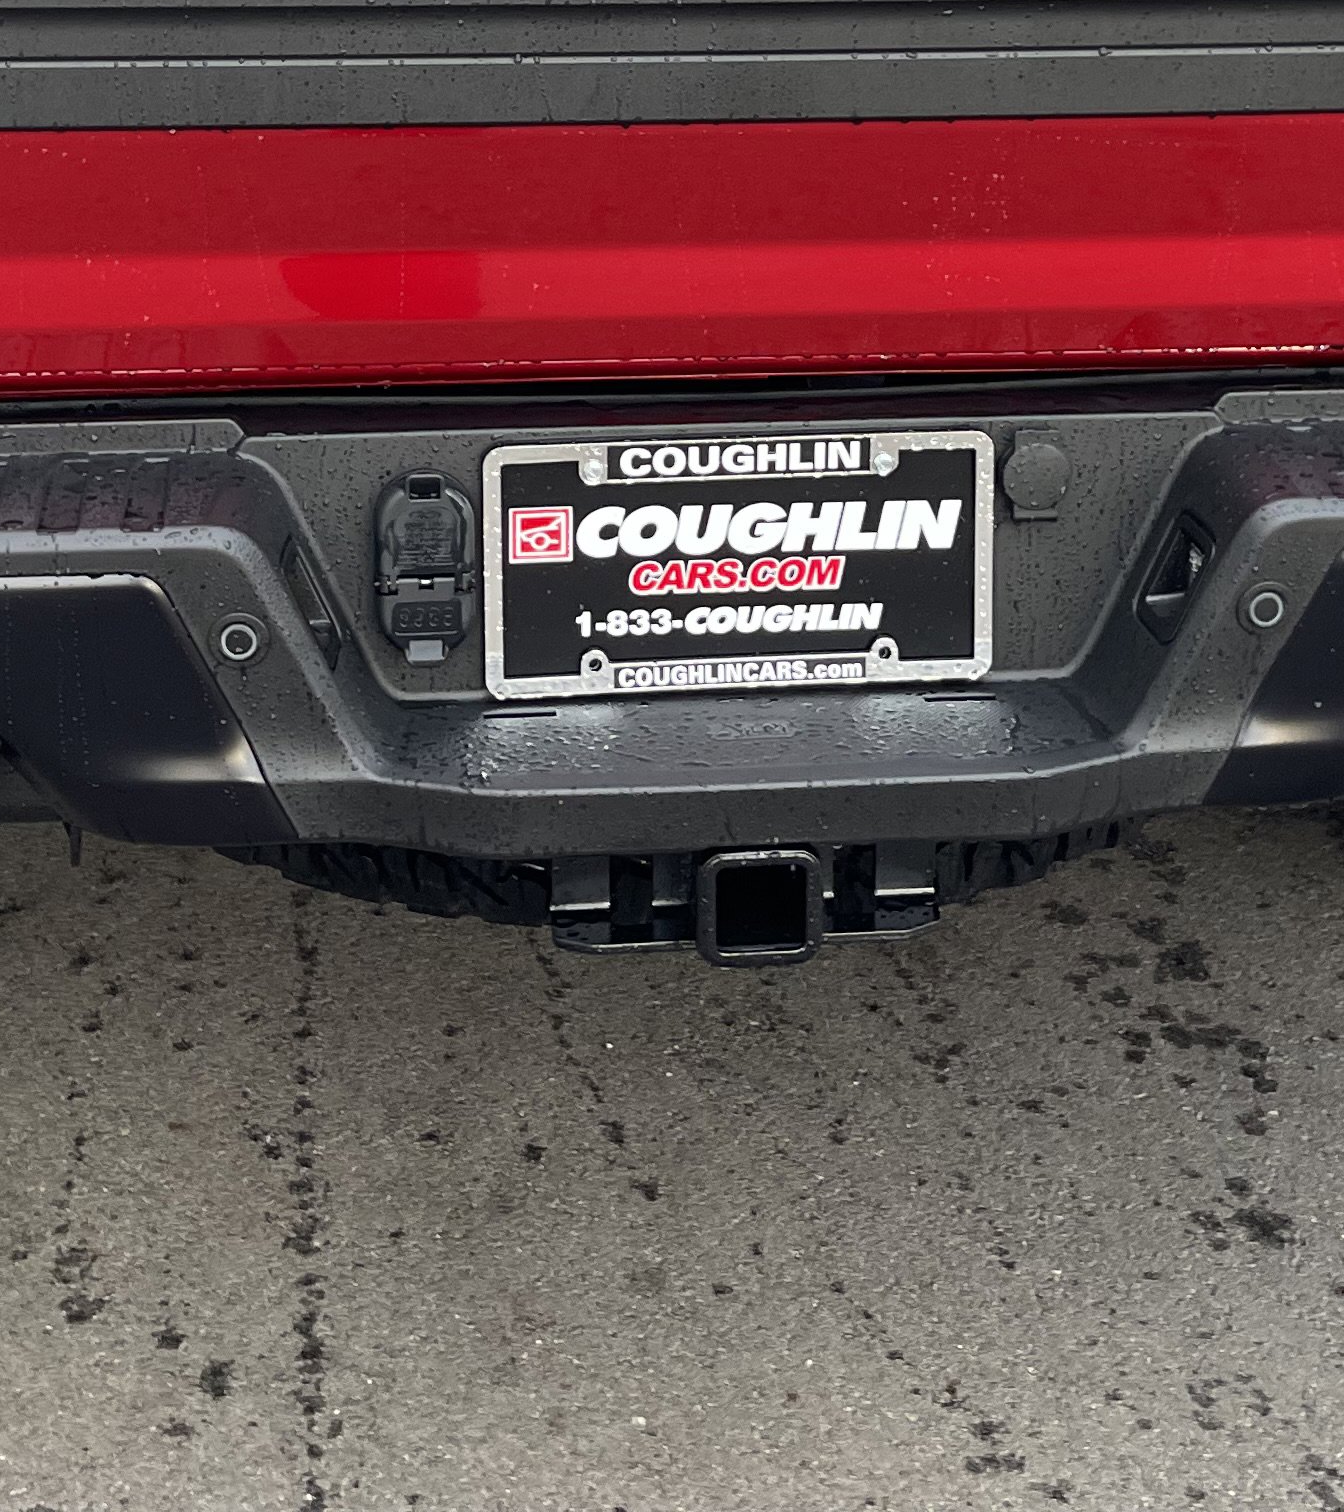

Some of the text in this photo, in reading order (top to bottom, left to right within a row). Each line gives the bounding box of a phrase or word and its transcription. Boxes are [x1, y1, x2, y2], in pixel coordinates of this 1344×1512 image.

[619, 440, 862, 477] COUGHLIN
[575, 498, 963, 558] COUGHLIN
[629, 555, 846, 595] CARS.COM
[575, 602, 883, 638] 1-833-COUGHLIN
[618, 660, 863, 688] COUGHLINCARS.com
